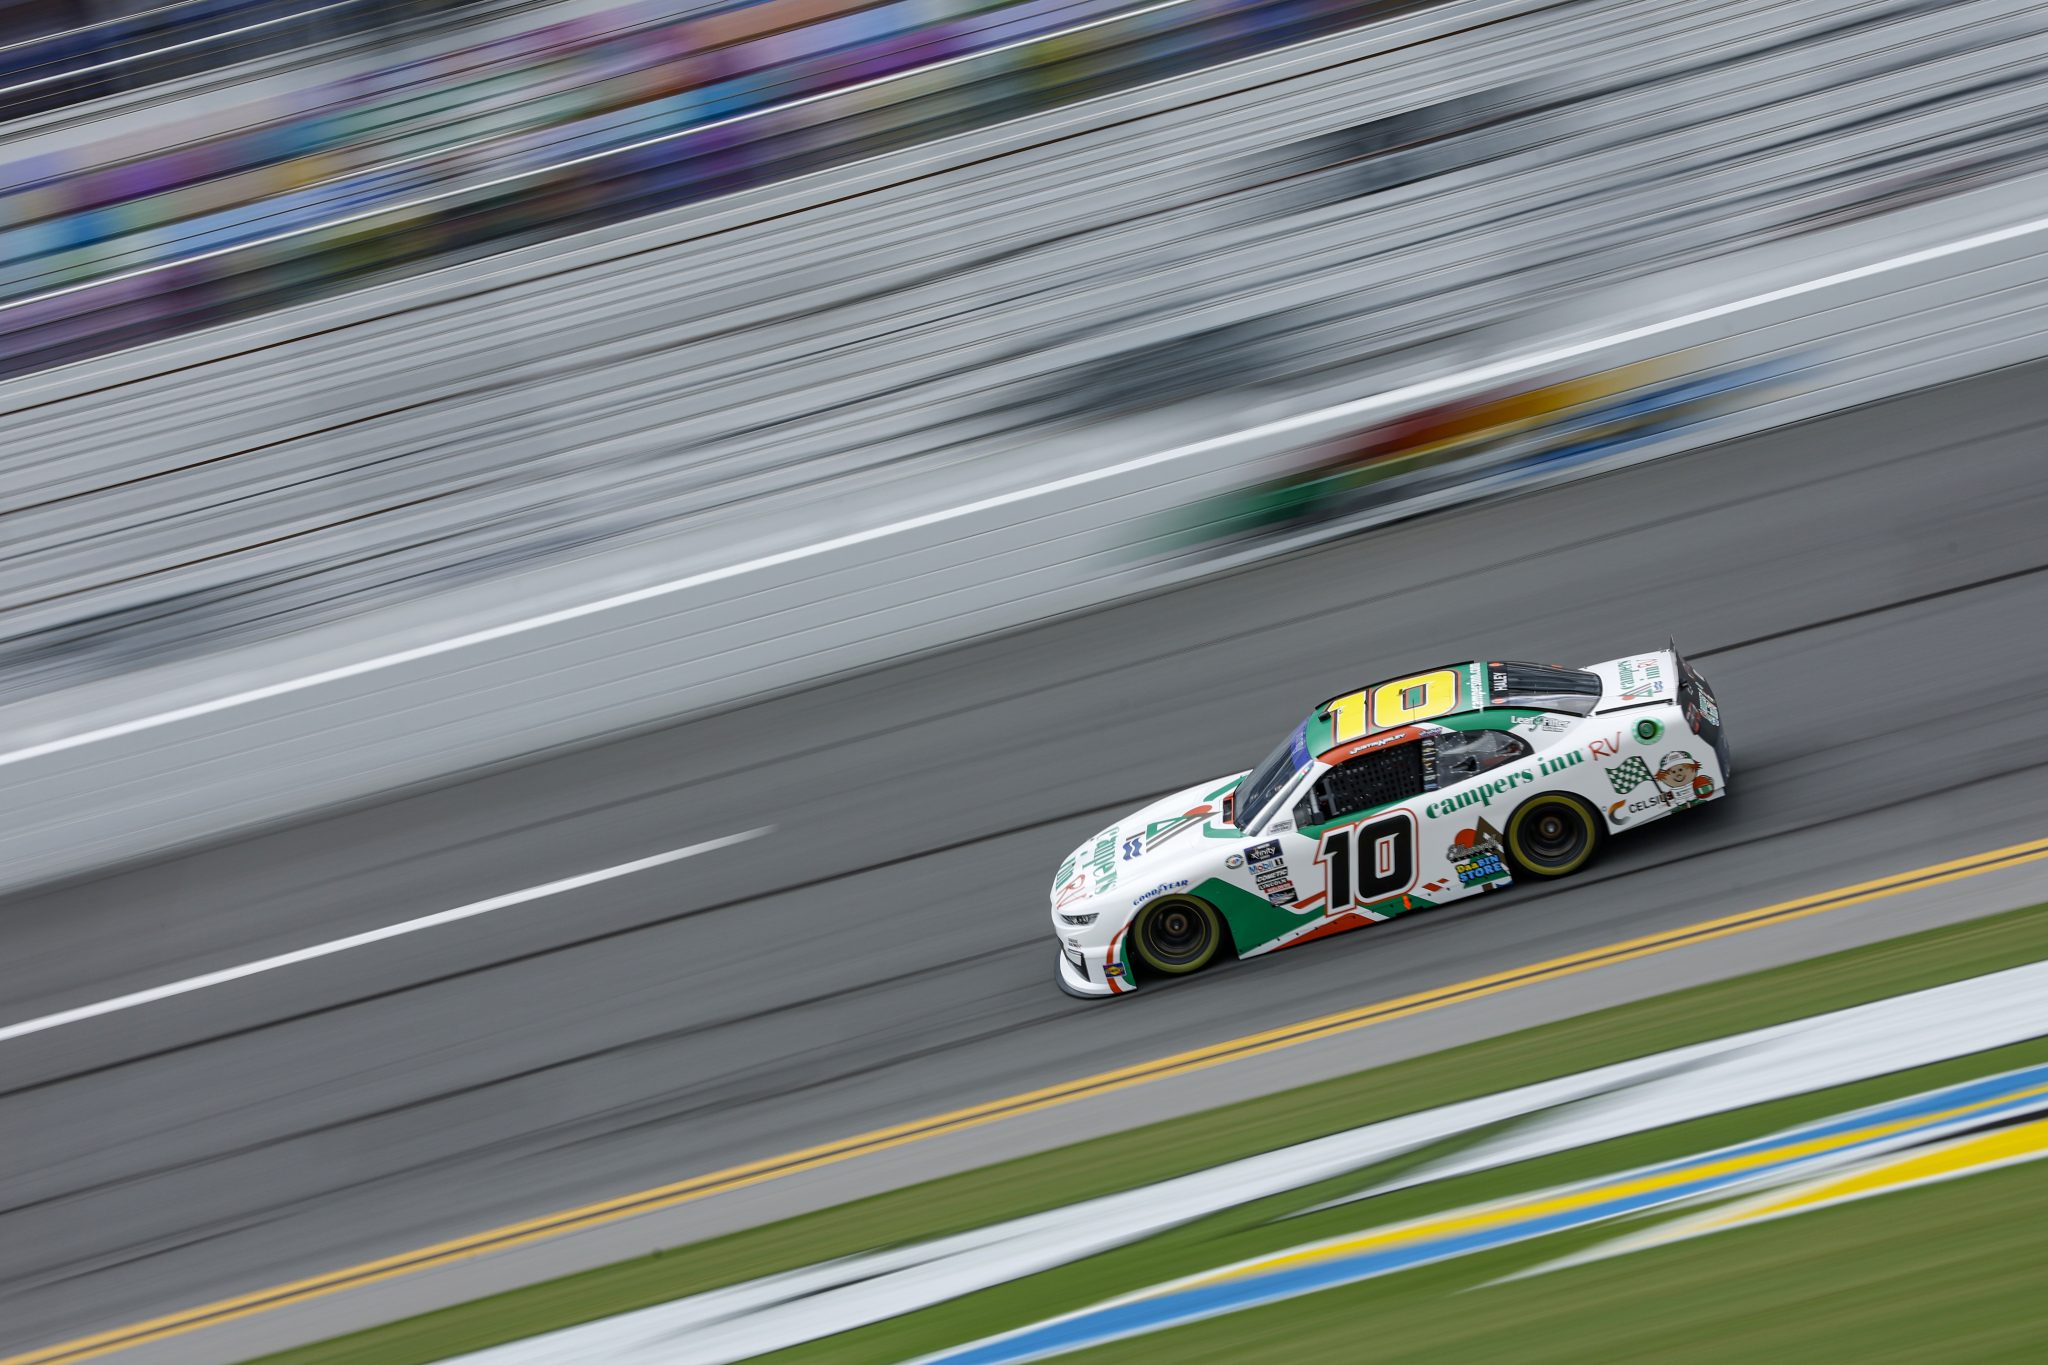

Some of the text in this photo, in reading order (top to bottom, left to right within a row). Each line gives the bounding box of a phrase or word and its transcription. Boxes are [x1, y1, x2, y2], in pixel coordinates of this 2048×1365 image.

[1493, 672, 1508, 691] HALEY
[1617, 660, 1638, 690] campers
[1640, 664, 1660, 681] inn
[1327, 669, 1460, 744] 10
[1425, 731, 1622, 819] campers inn RV
[1055, 852, 1087, 892] inn
[1082, 825, 1120, 896] campers
[1248, 861, 1274, 875] Mobil
[1321, 812, 1415, 912] 10
[1458, 862, 1502, 884] STORE
